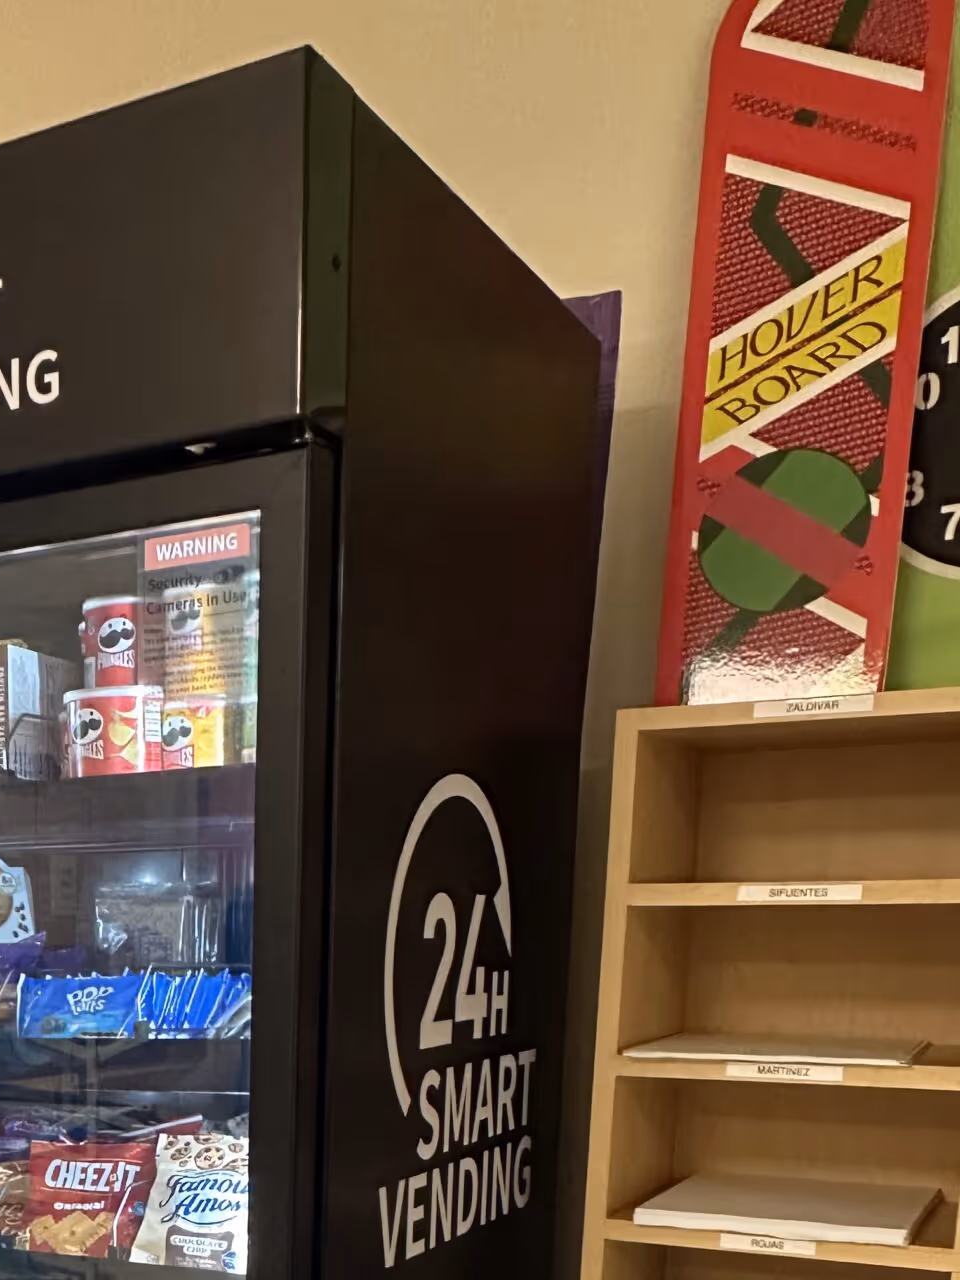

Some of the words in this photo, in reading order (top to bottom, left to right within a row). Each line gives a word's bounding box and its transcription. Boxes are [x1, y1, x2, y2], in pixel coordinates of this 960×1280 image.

[718, 255, 884, 381] HOVER
[715, 320, 887, 426] BOARD
[147, 571, 202, 592] Security
[156, 532, 238, 562] WARNING
[206, 594, 219, 607] In
[416, 1048, 536, 1161] SMART
[378, 1136, 531, 1268] VENDING
